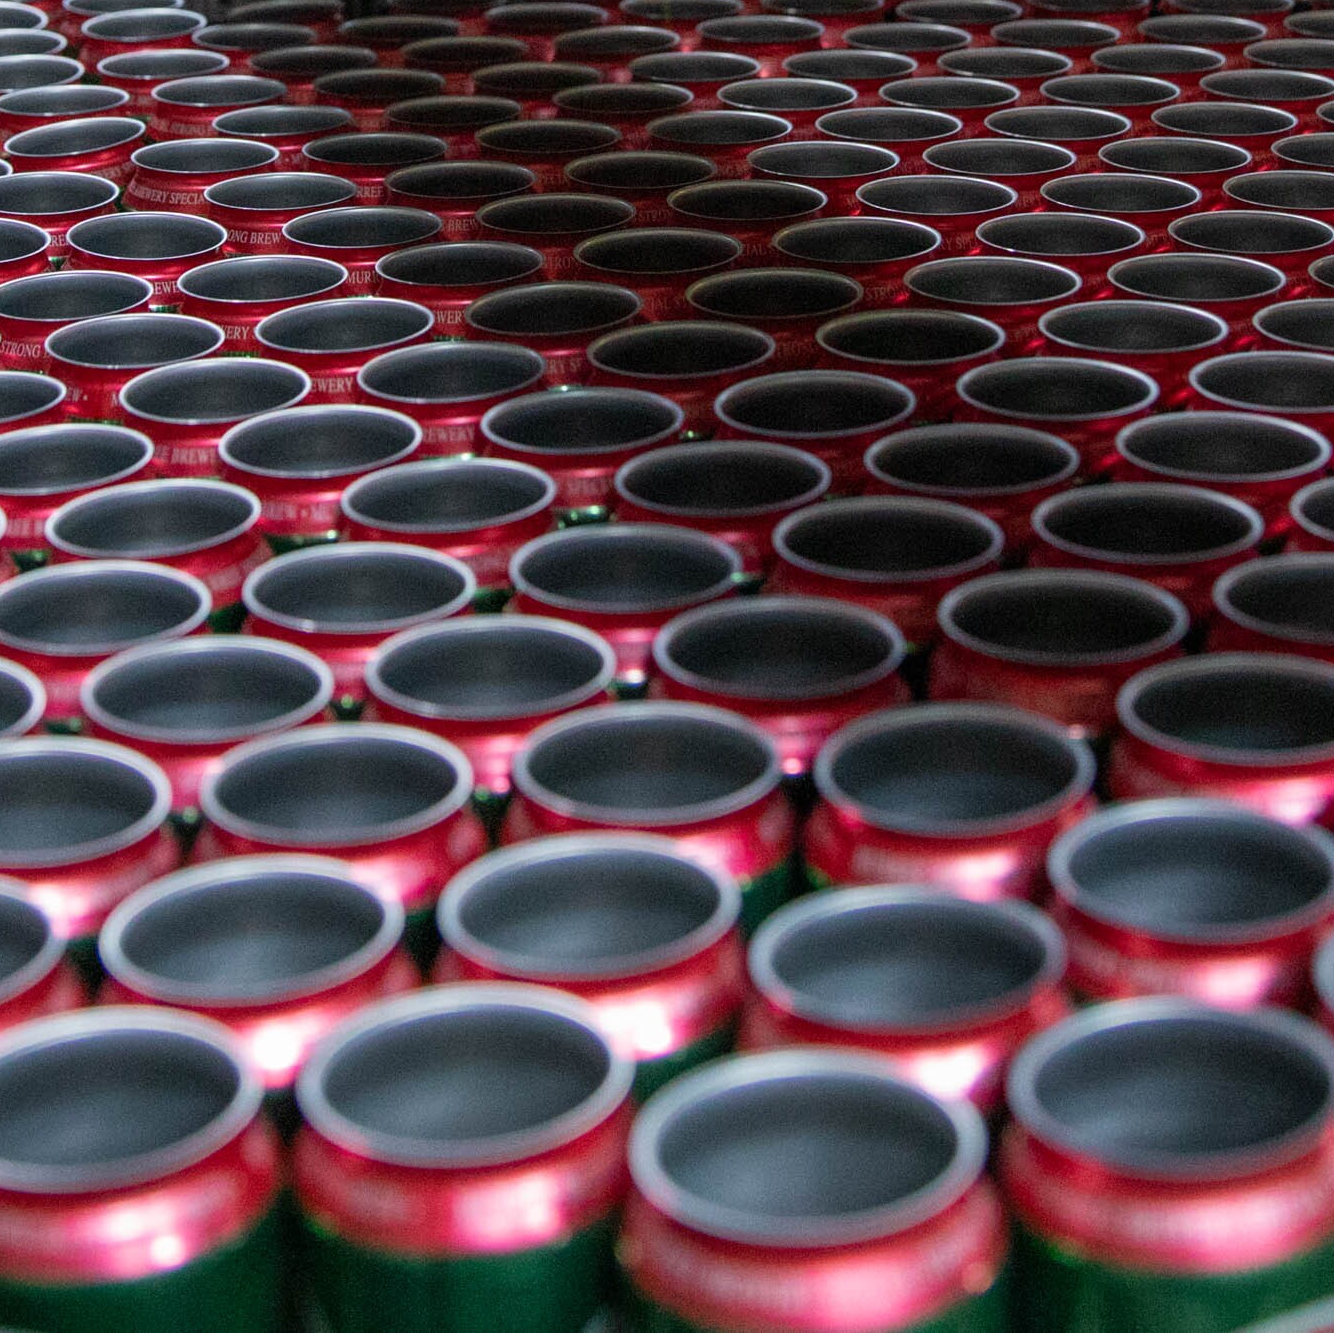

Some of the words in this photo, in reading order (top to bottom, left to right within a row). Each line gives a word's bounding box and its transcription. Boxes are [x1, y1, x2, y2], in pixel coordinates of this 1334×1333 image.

[169, 192, 205, 205] SPECIA
[227, 229, 249, 244] ONG
[249, 231, 282, 245] BREW
[0, 341, 41, 358] STRONG
[311, 377, 353, 394] EWERY
